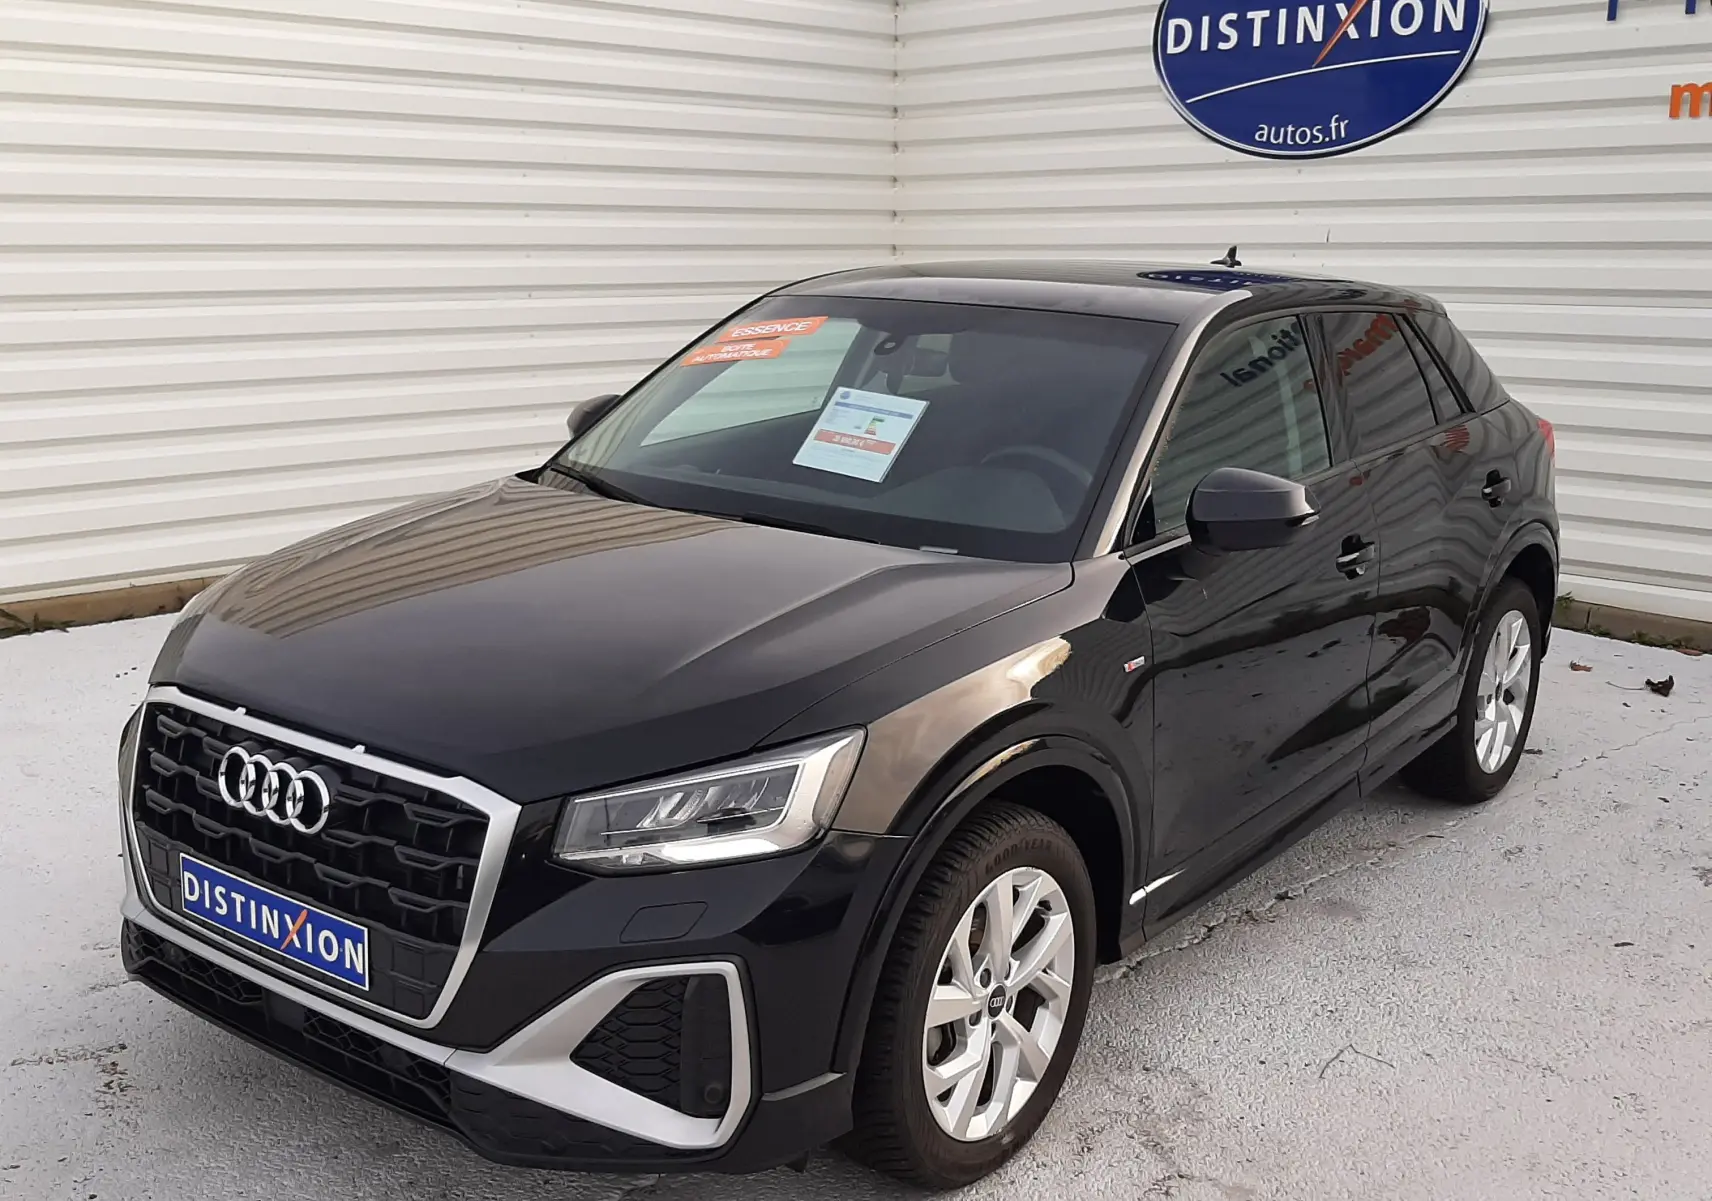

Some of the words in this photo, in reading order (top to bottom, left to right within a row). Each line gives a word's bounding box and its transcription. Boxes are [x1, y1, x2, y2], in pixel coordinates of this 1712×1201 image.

[1166, 0, 1465, 60] DISTINXION
[1254, 114, 1349, 145] autos.fr
[731, 320, 813, 338] ESSENCE
[690, 348, 774, 363] AUTOMATIQUE
[182, 870, 364, 976] DISTINXION
